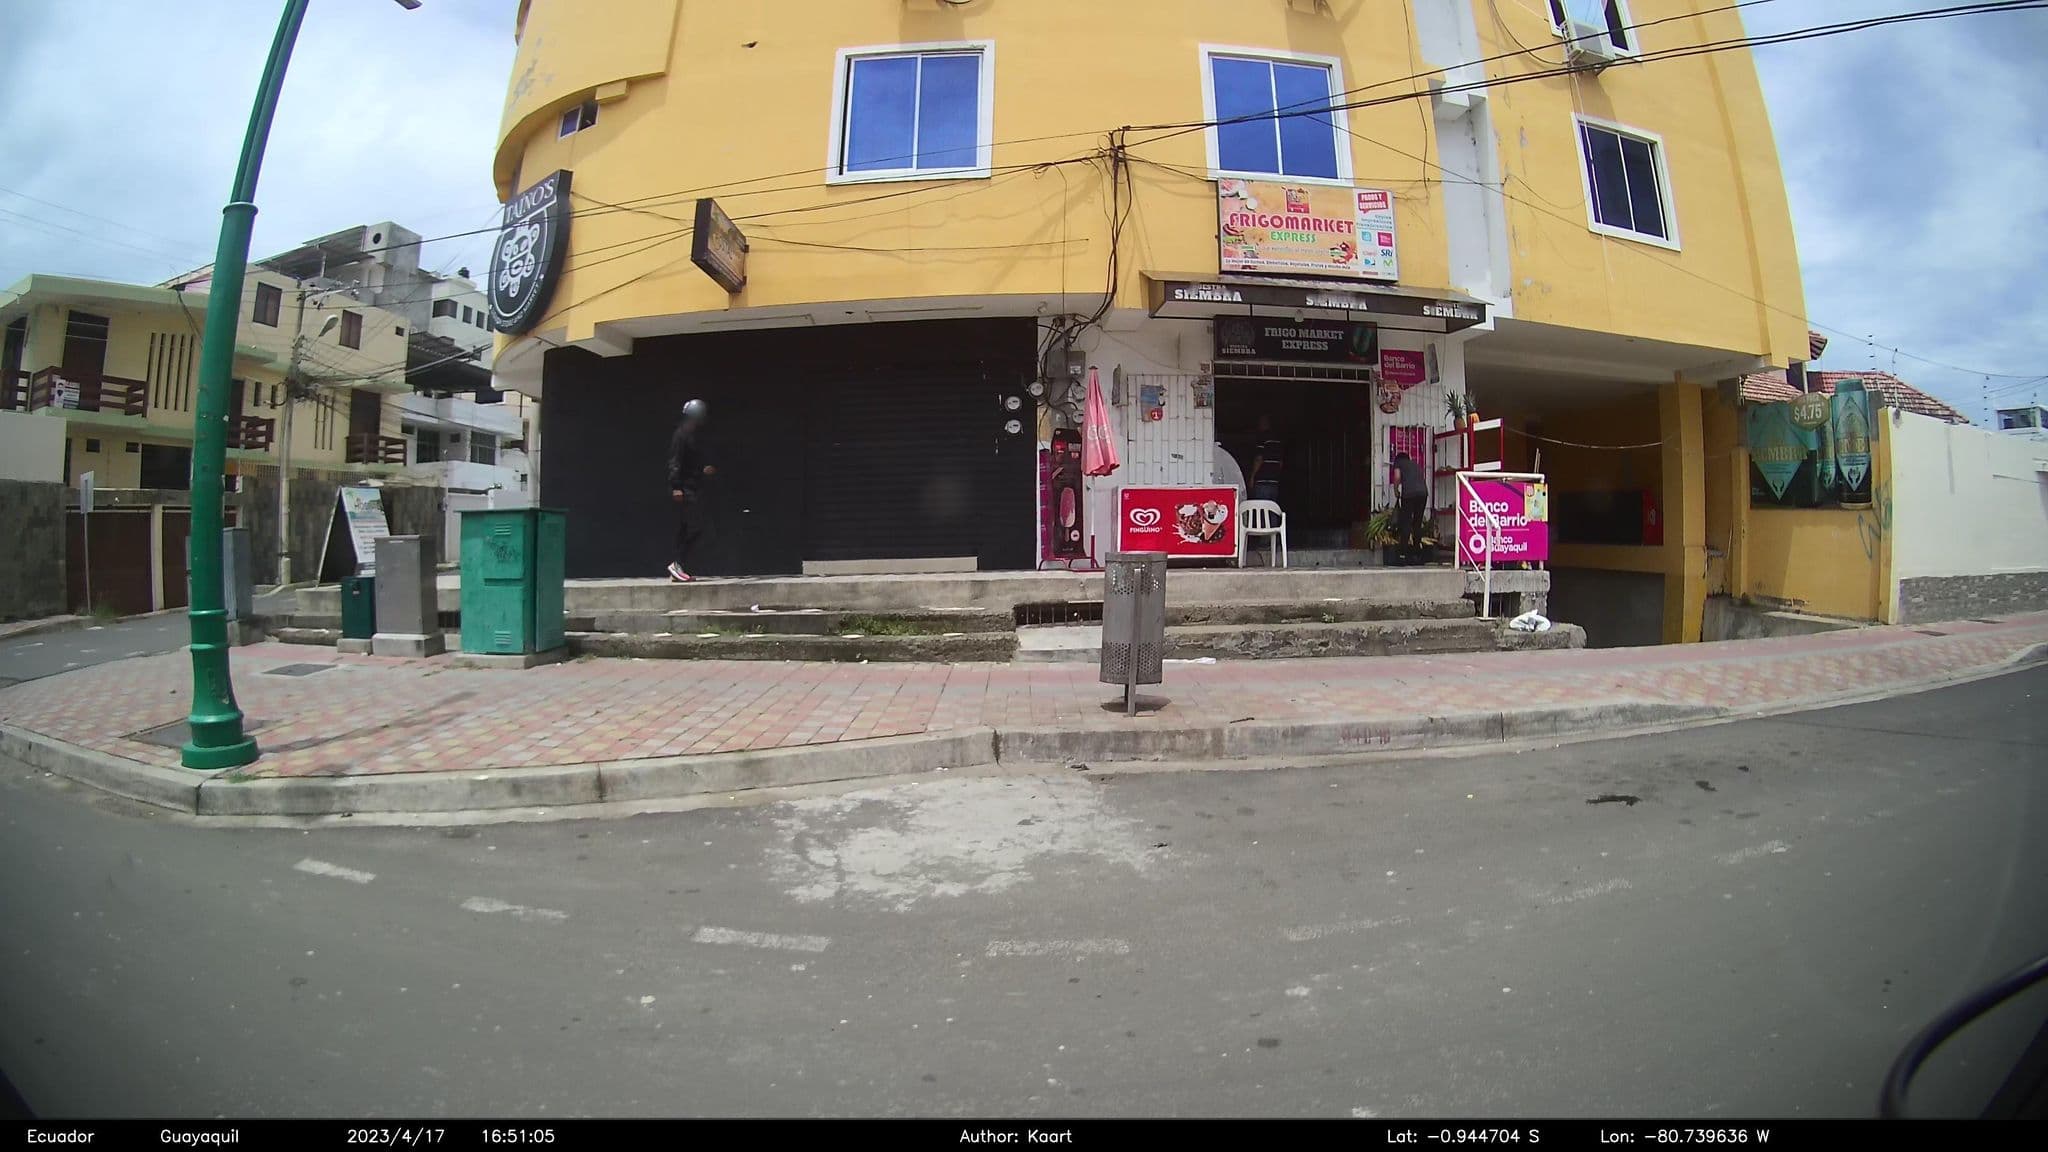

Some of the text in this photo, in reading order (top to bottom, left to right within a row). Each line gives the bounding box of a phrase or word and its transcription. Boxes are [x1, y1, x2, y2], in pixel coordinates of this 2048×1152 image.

[1229, 212, 1354, 234] FRIGOMARKET
[1270, 231, 1316, 243] EXPRESS
[1265, 327, 1344, 340] FRIGO MARKET
[1281, 339, 1329, 351] EXPRESS
